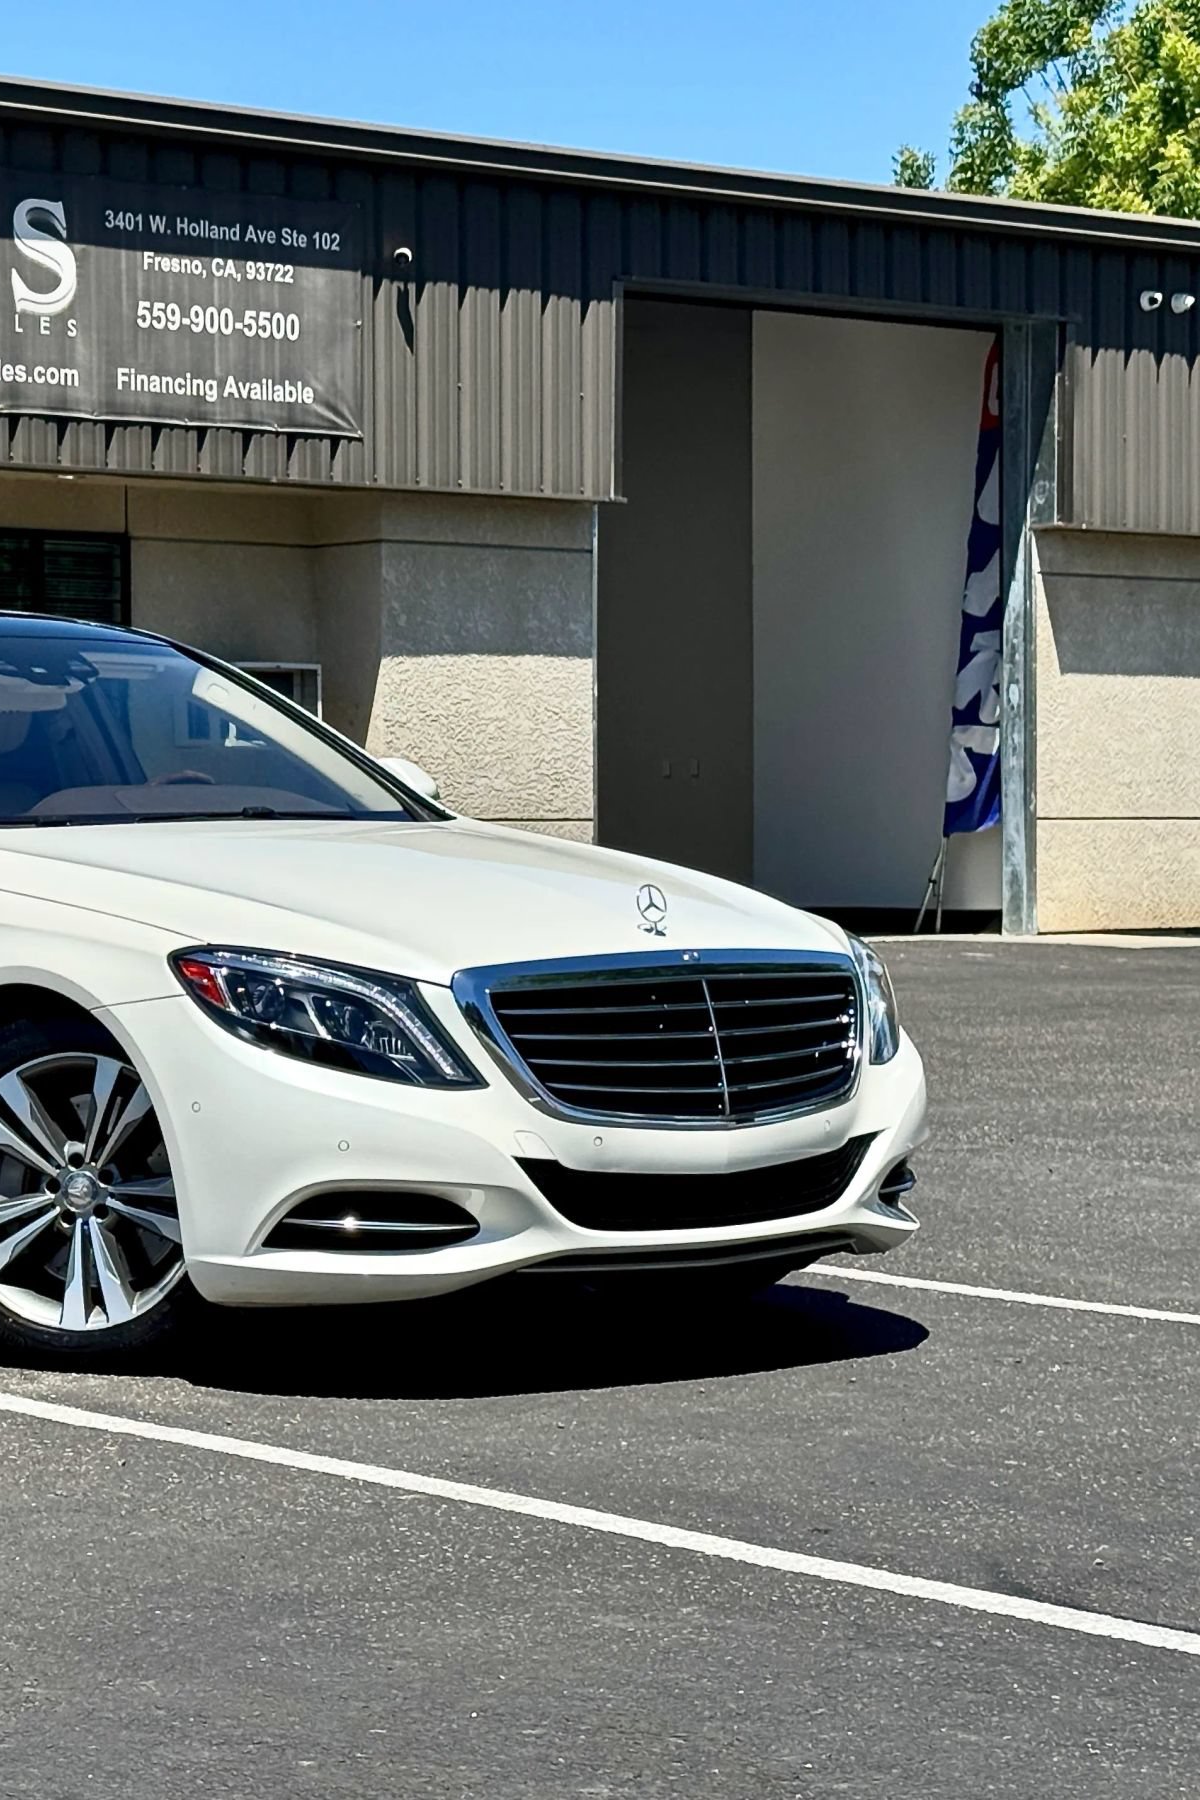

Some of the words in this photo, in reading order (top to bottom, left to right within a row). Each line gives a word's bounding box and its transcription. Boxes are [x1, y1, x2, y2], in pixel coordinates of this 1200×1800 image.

[104, 209, 144, 234] 3401
[150, 213, 173, 236] W.
[176, 215, 240, 242] Holland
[245, 223, 278, 245] Ave
[281, 226, 309, 248] Ste
[313, 230, 341, 252] 102
[142, 251, 207, 279] Fresno,
[211, 257, 242, 281] CA,
[245, 261, 295, 284] 93722
[136, 301, 300, 341] 559-900-5500
[116, 368, 218, 402] Financing
[223, 376, 314, 405] Available
